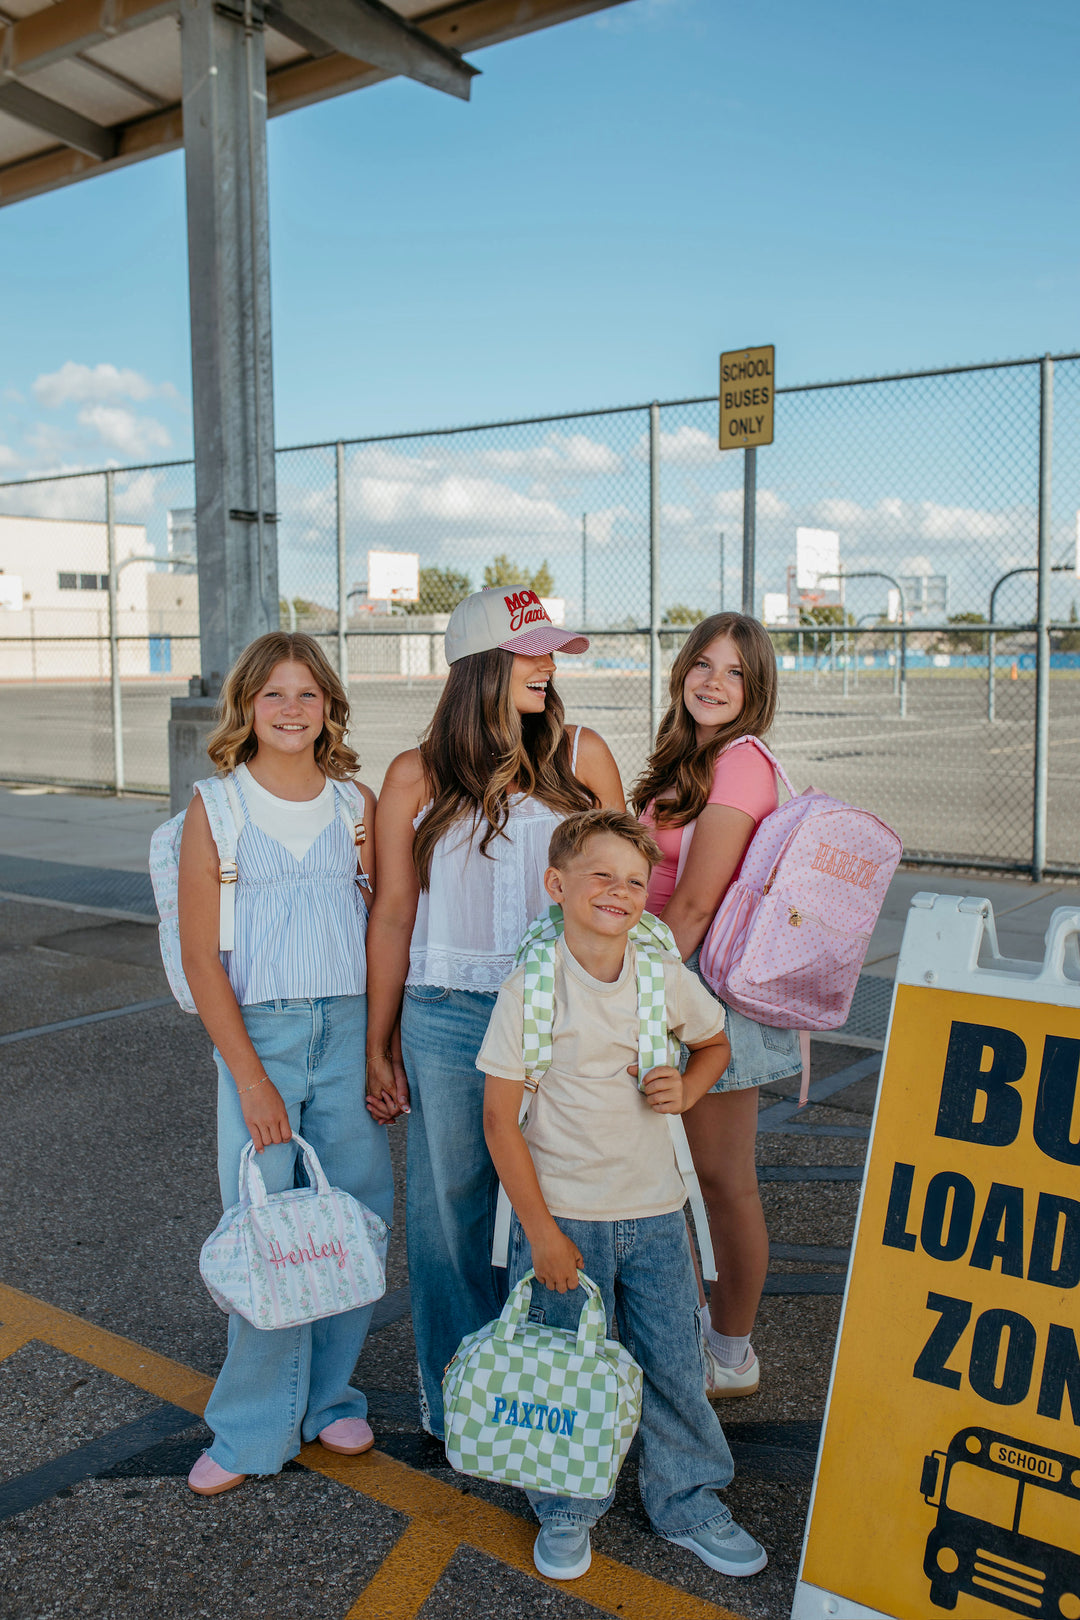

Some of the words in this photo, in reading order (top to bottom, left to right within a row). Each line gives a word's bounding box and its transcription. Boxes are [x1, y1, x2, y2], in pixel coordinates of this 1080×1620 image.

[723, 358, 772, 382] SCHOOL
[724, 386, 770, 409] BUSES
[728, 415, 765, 436] ONLY
[810, 841, 880, 890] HARLYN
[881, 1161, 1080, 1289] LOAD
[269, 1232, 350, 1271] Henley
[491, 1396, 578, 1437] PAXTON
[998, 1447, 1056, 1478] SCHOOL
